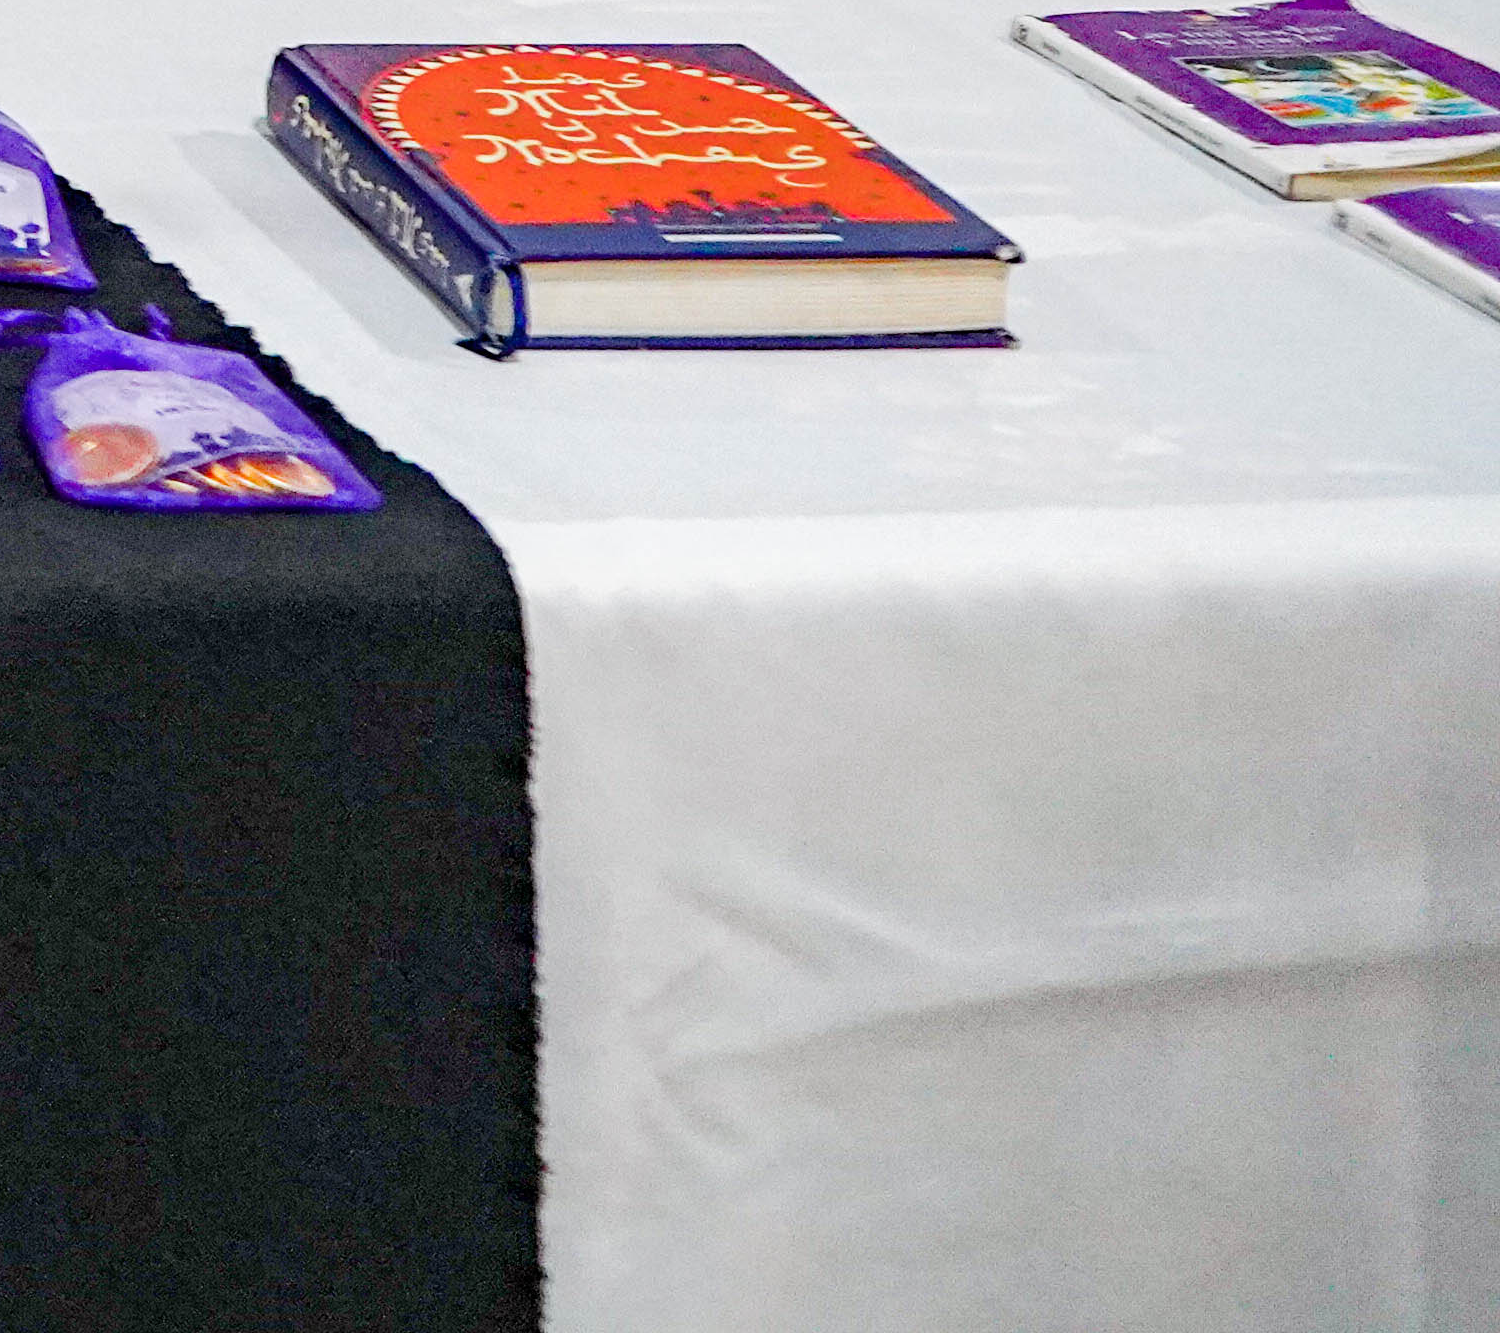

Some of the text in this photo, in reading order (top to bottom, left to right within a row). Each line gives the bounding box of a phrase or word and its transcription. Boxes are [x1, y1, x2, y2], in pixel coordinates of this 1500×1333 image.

[502, 66, 647, 89] Las
[475, 89, 660, 119] Mil
[542, 119, 598, 142] y
[461, 134, 828, 170] Noches
